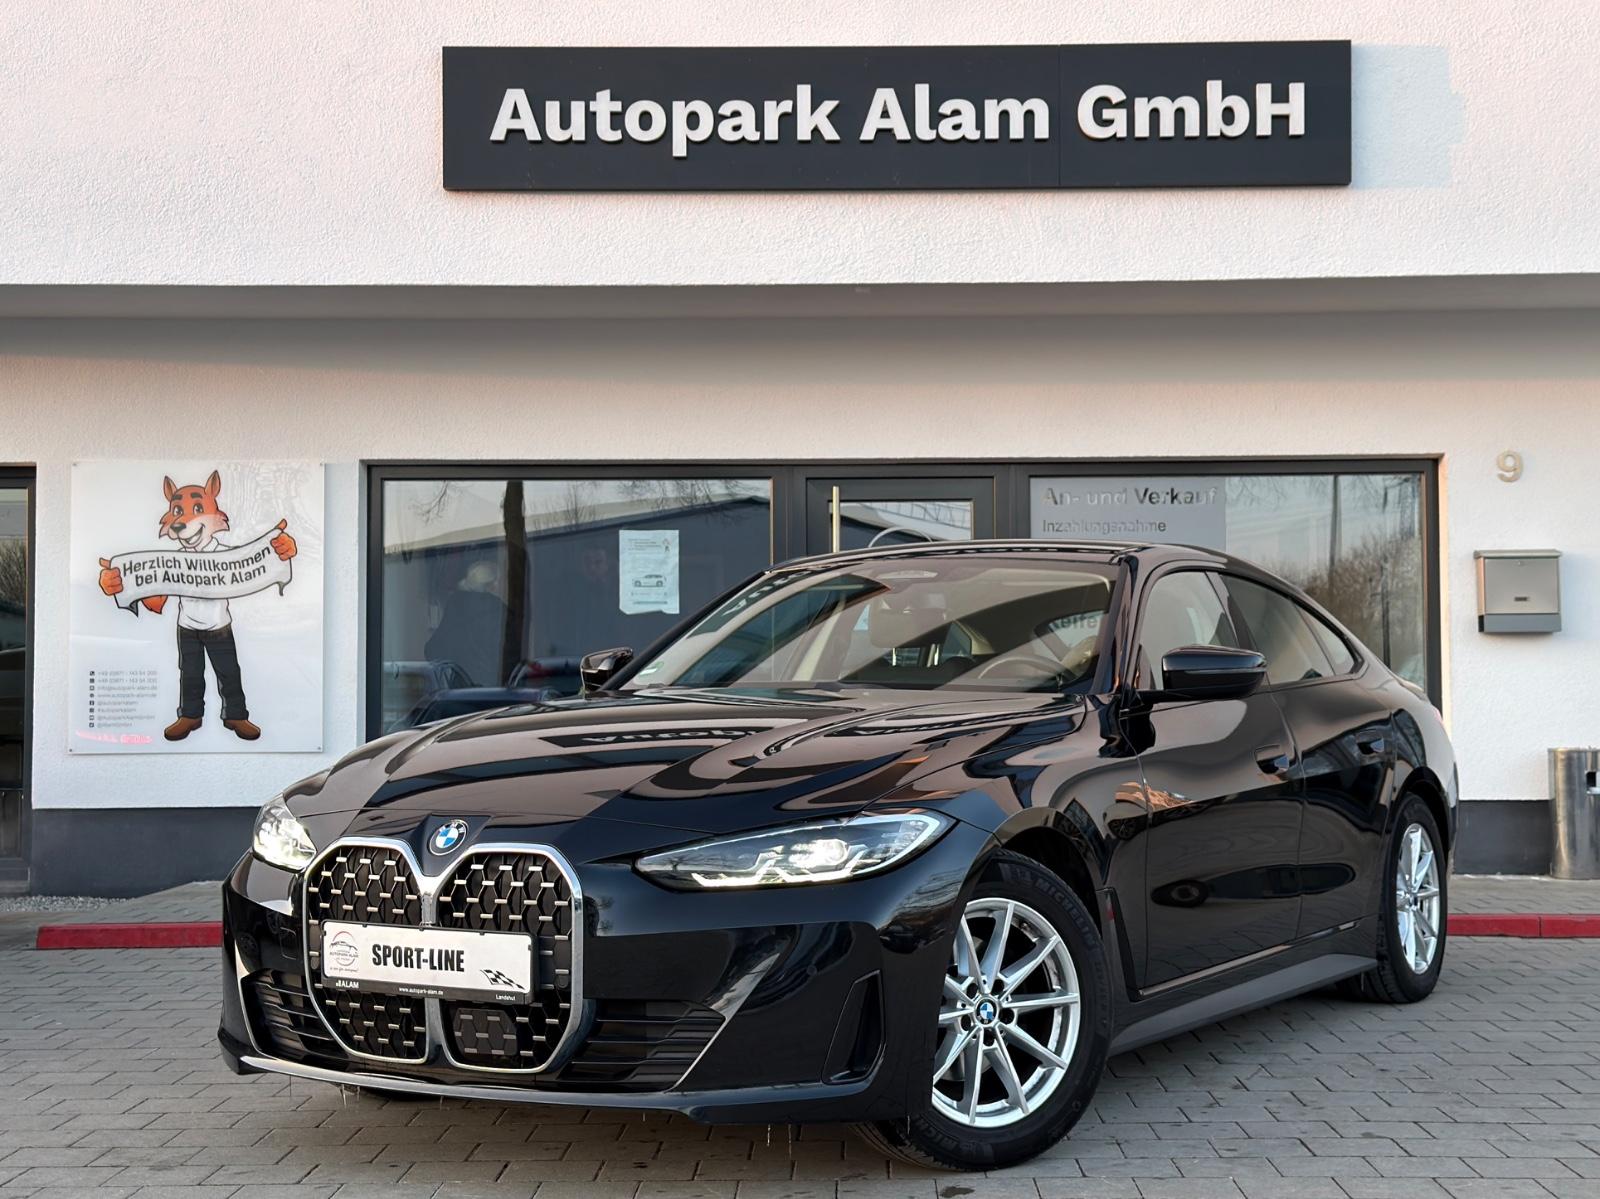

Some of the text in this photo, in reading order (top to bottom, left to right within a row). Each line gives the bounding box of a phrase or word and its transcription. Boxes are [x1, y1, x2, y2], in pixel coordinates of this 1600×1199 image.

[489, 79, 1306, 158] Autopark Alam GmbH
[1496, 449, 1523, 483] 9
[1087, 487, 1128, 506] und
[1134, 486, 1218, 506] Verkauf
[1042, 519, 1167, 535] Inzahlungsnahme
[123, 545, 271, 578] Herzlich Willkommen
[135, 564, 267, 588] bei Autopark Alam
[1034, 878, 1096, 948] MICHELIN
[372, 943, 465, 973] SPORT-LINE
